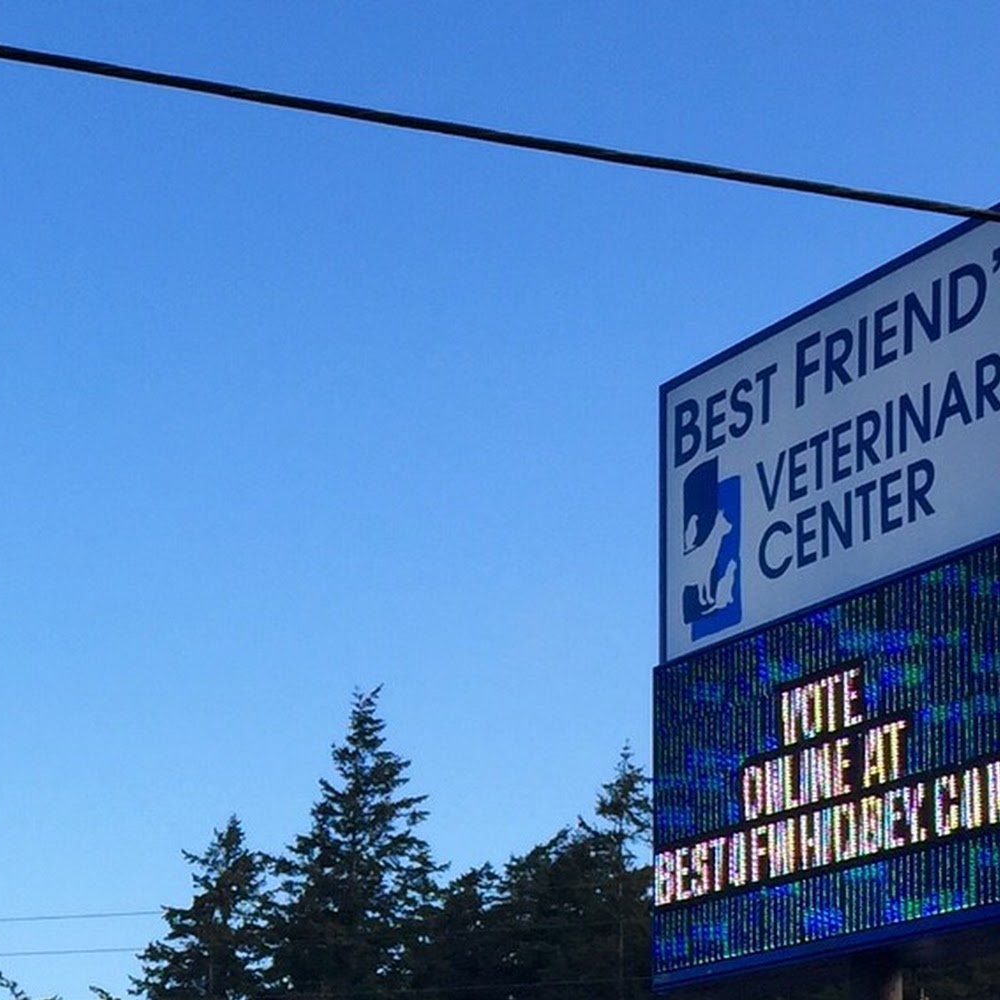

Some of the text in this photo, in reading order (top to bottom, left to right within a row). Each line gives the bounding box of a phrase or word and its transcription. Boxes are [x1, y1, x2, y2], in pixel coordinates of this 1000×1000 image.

[674, 363, 777, 468] BEST
[756, 353, 1000, 511] VETERINAR
[758, 458, 935, 579] CENTER
[780, 667, 863, 747] VOTE
[743, 719, 907, 821] ONLINE AT
